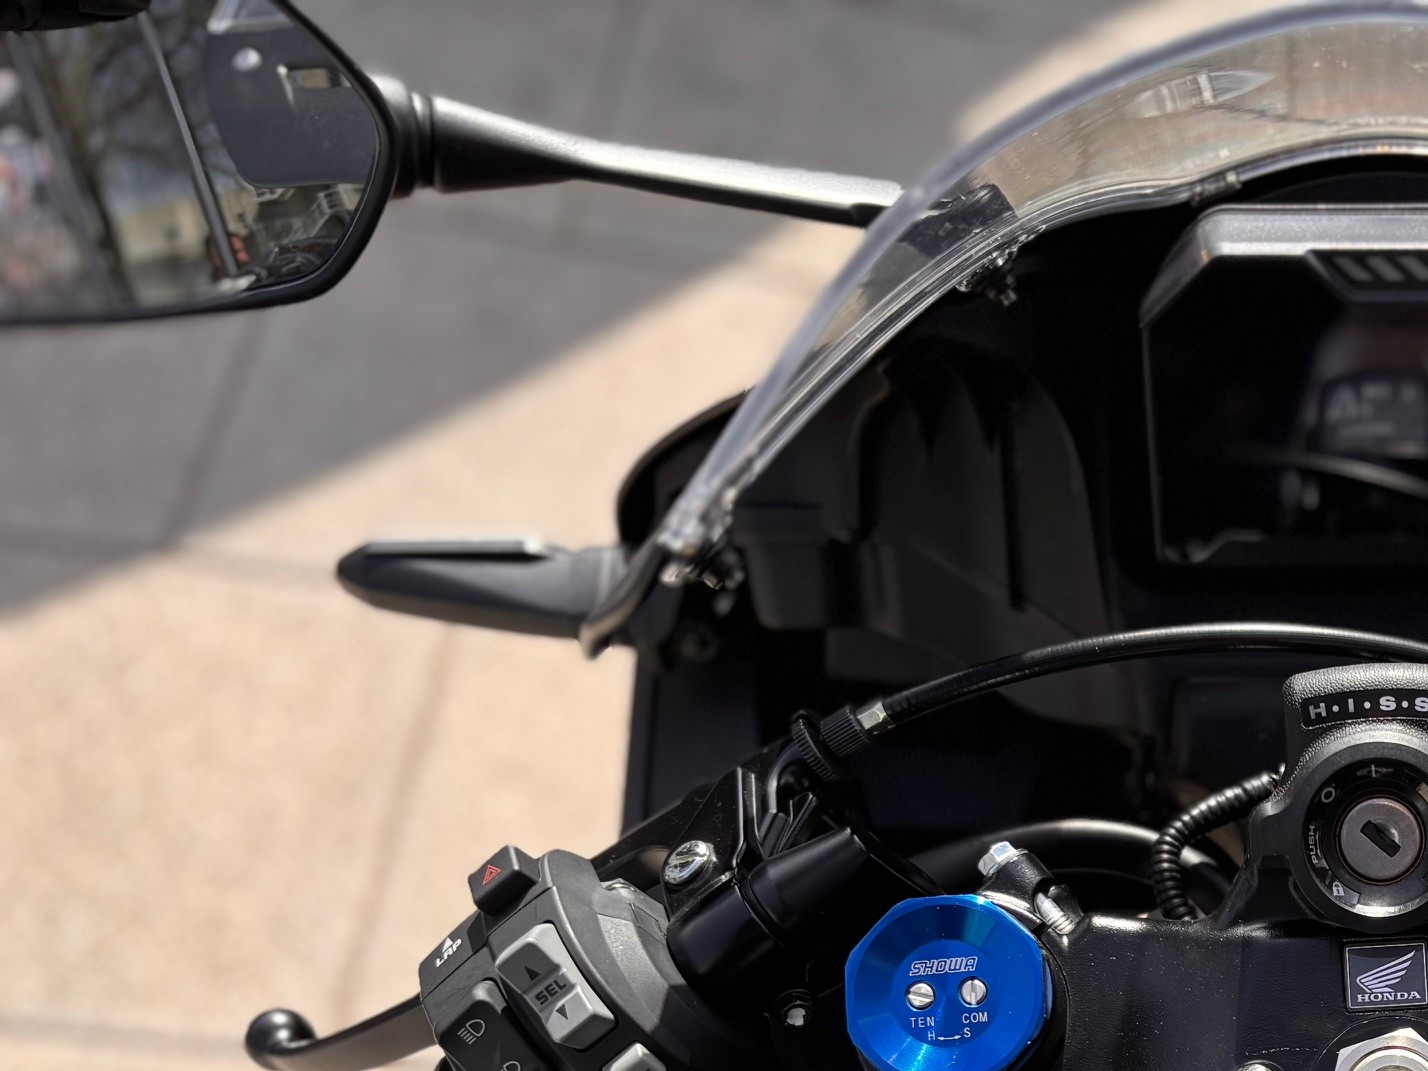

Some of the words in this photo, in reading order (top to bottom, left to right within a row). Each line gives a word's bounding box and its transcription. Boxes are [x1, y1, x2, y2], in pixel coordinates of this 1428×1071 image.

[1305, 825, 1316, 865] PUSH
[435, 938, 462, 968] LAP
[909, 956, 978, 977] SHOWA
[534, 979, 567, 1006] SEL
[1356, 991, 1422, 1003] HONDA
[910, 1016, 935, 1028] TEN
[962, 1011, 988, 1024] COM
[927, 1030, 936, 1041] H
[963, 1027, 972, 1038] S
